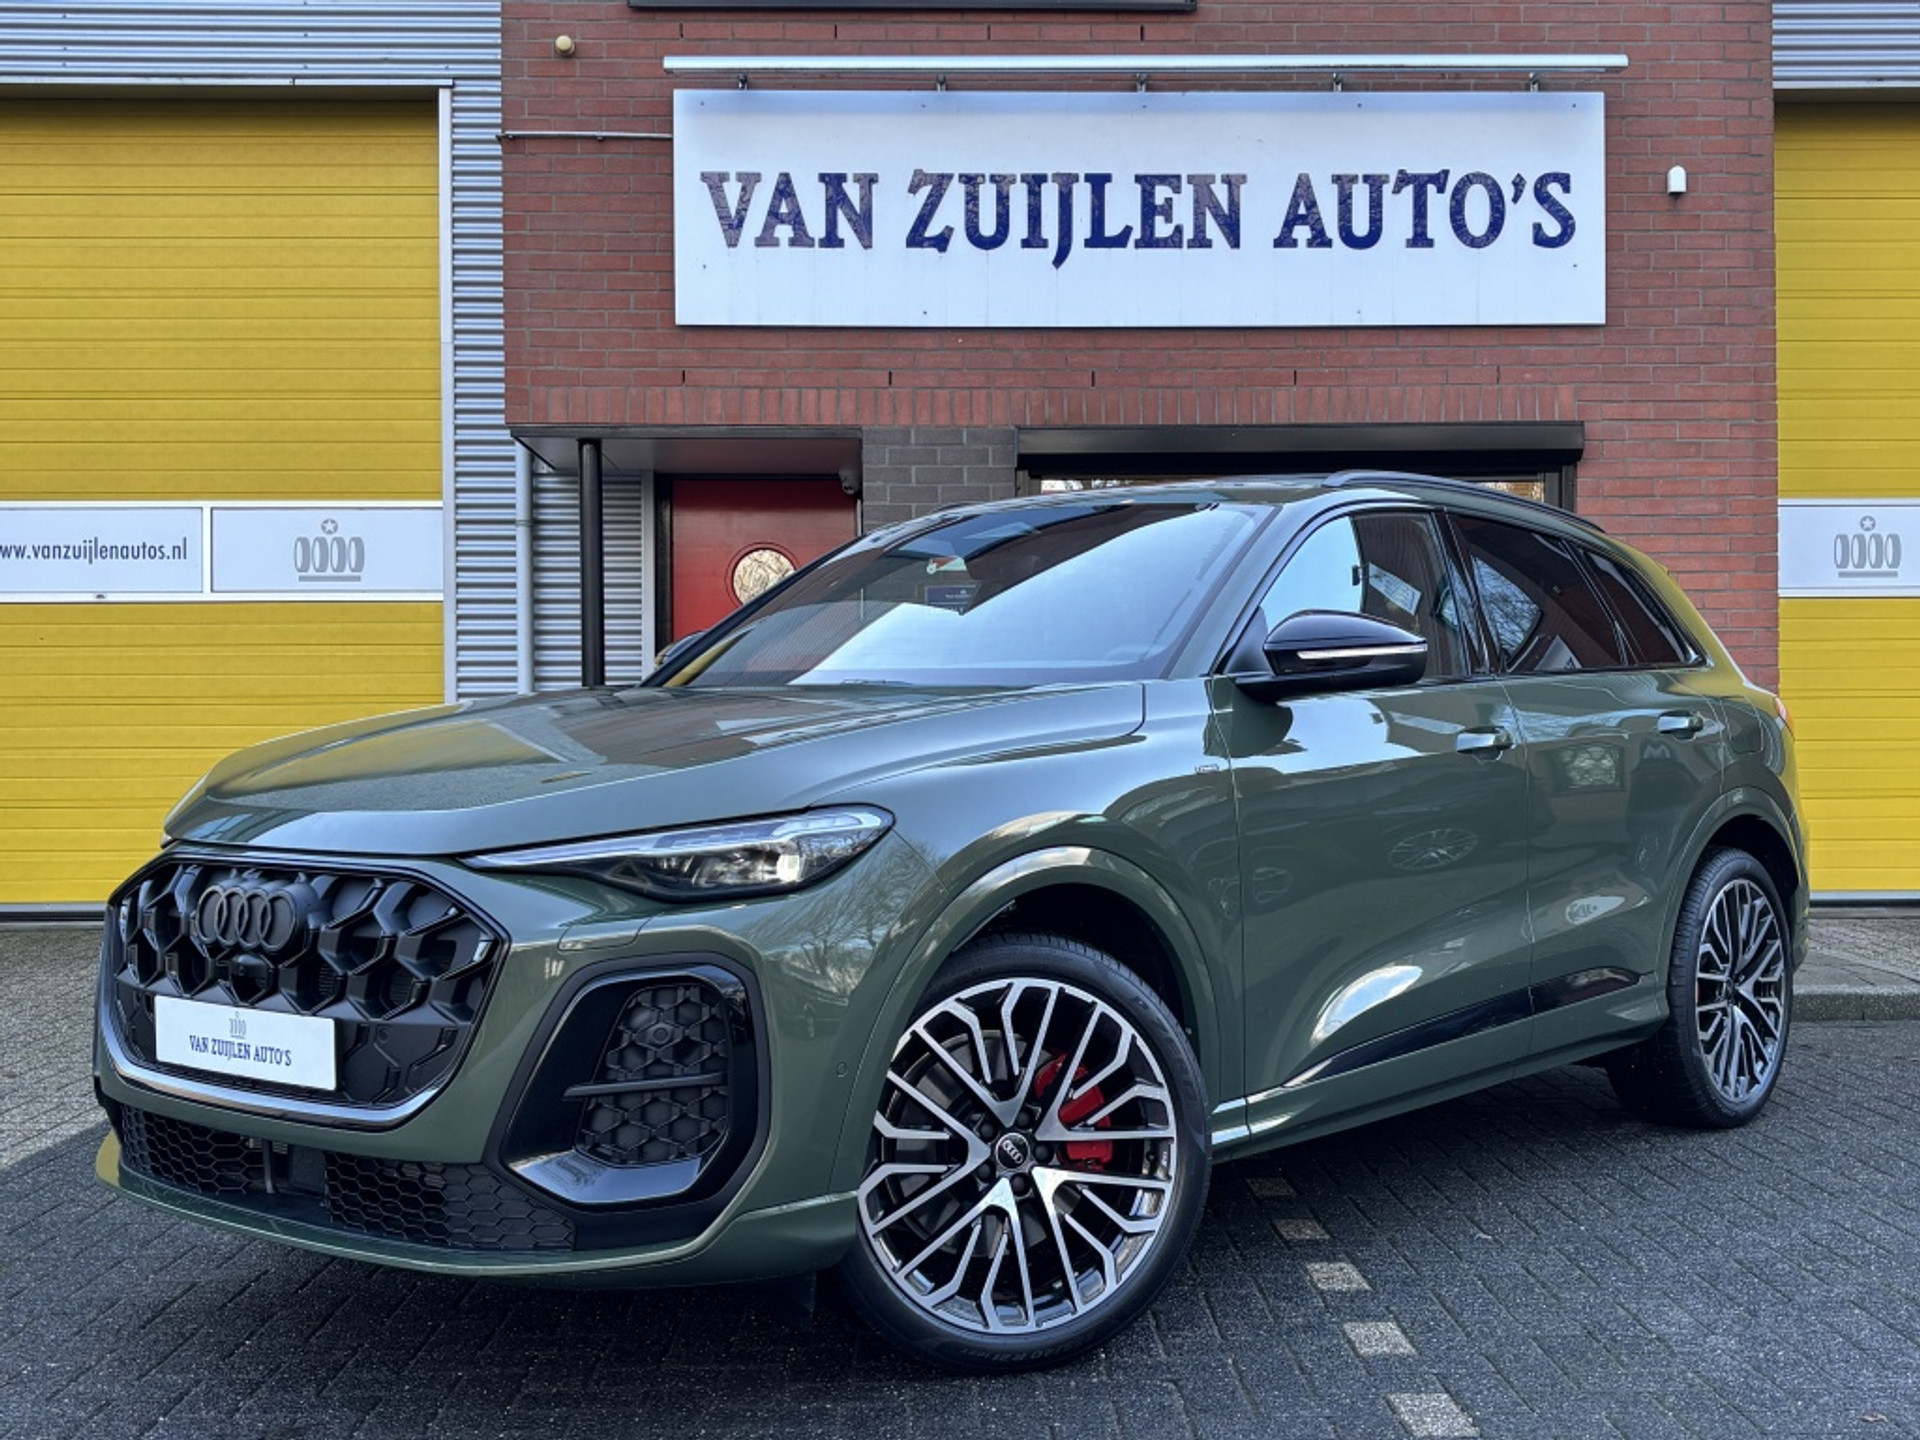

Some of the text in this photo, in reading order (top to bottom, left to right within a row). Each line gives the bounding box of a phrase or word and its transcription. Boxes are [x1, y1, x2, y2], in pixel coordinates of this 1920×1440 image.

[700, 168, 1576, 270] VAN ZUIJLEN AUTO'S
[189, 1035, 292, 1066] VAN ZUIJLEN AUTO'S
